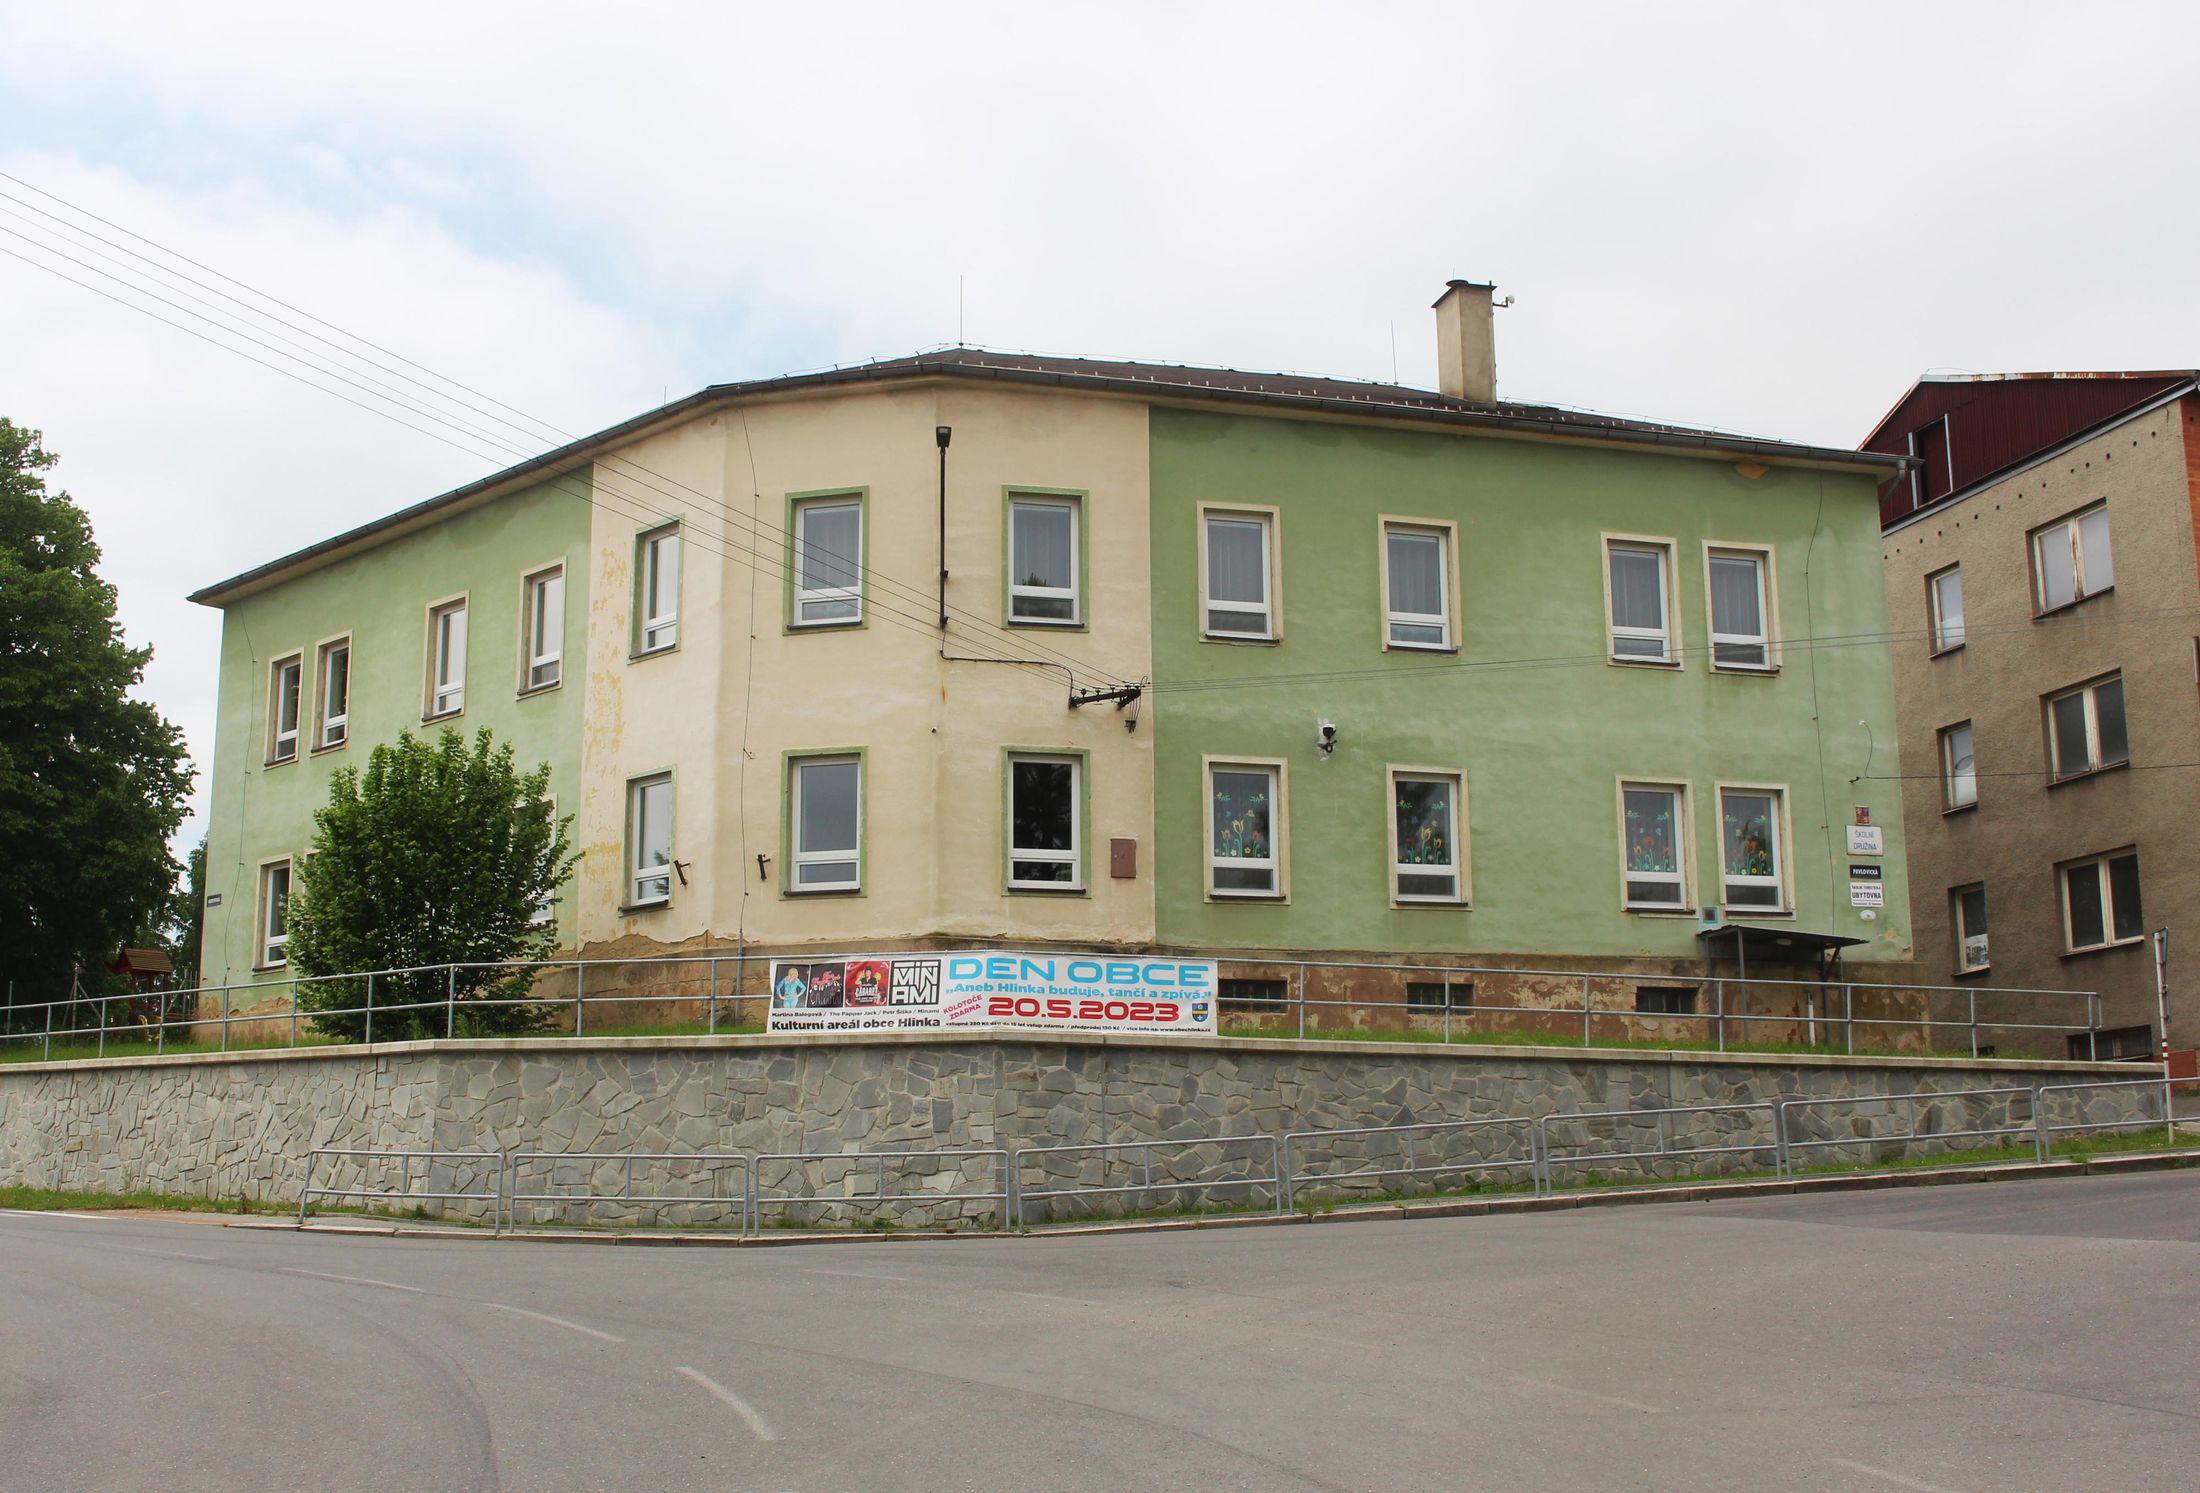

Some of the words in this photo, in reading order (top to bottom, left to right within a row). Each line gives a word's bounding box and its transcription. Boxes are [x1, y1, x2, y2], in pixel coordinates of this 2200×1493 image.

[1853, 841, 1877, 850] DRUŽINA
[949, 957, 1054, 981] DEN
[1067, 961, 1209, 986] OBCE
[997, 983, 1045, 994] Hlinka
[1049, 985, 1104, 997] buduje,
[1108, 987, 1145, 998] tančí
[1149, 990, 1158, 998] a
[942, 993, 983, 1014] KOLOTOČE
[949, 1003, 981, 1020] ZDARMA
[988, 997, 1180, 1021] 20.5.2023
[772, 1019, 824, 1030] Kulturní
[827, 1018, 859, 1029] areál
[863, 1017, 895, 1028] obce
[898, 1016, 941, 1027] Hlinka
